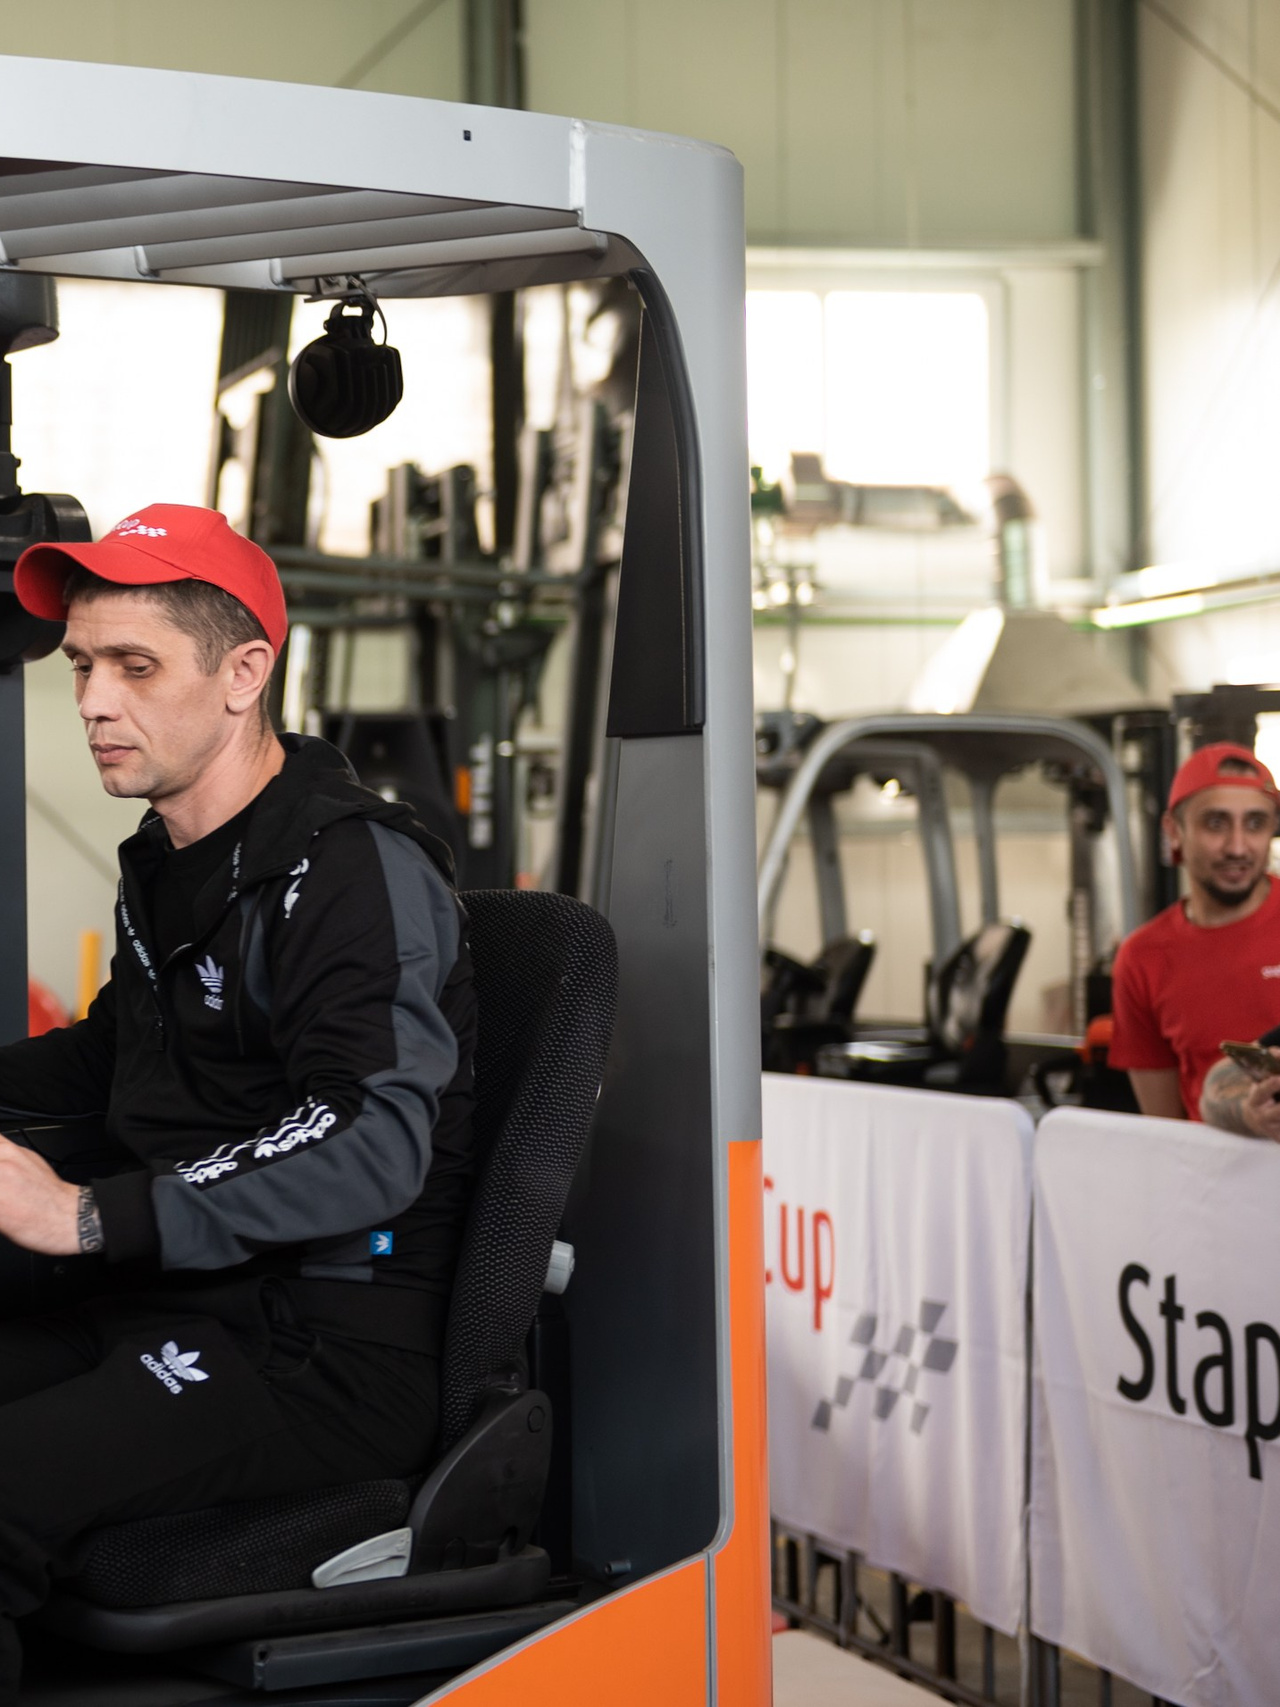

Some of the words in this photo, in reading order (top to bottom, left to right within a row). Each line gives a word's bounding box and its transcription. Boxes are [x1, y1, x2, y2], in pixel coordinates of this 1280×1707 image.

[132, 939, 152, 967] adidas
[764, 1176, 836, 1332] up
[140, 1353, 183, 1395] adidas
[1117, 1262, 1280, 1482] Stap
